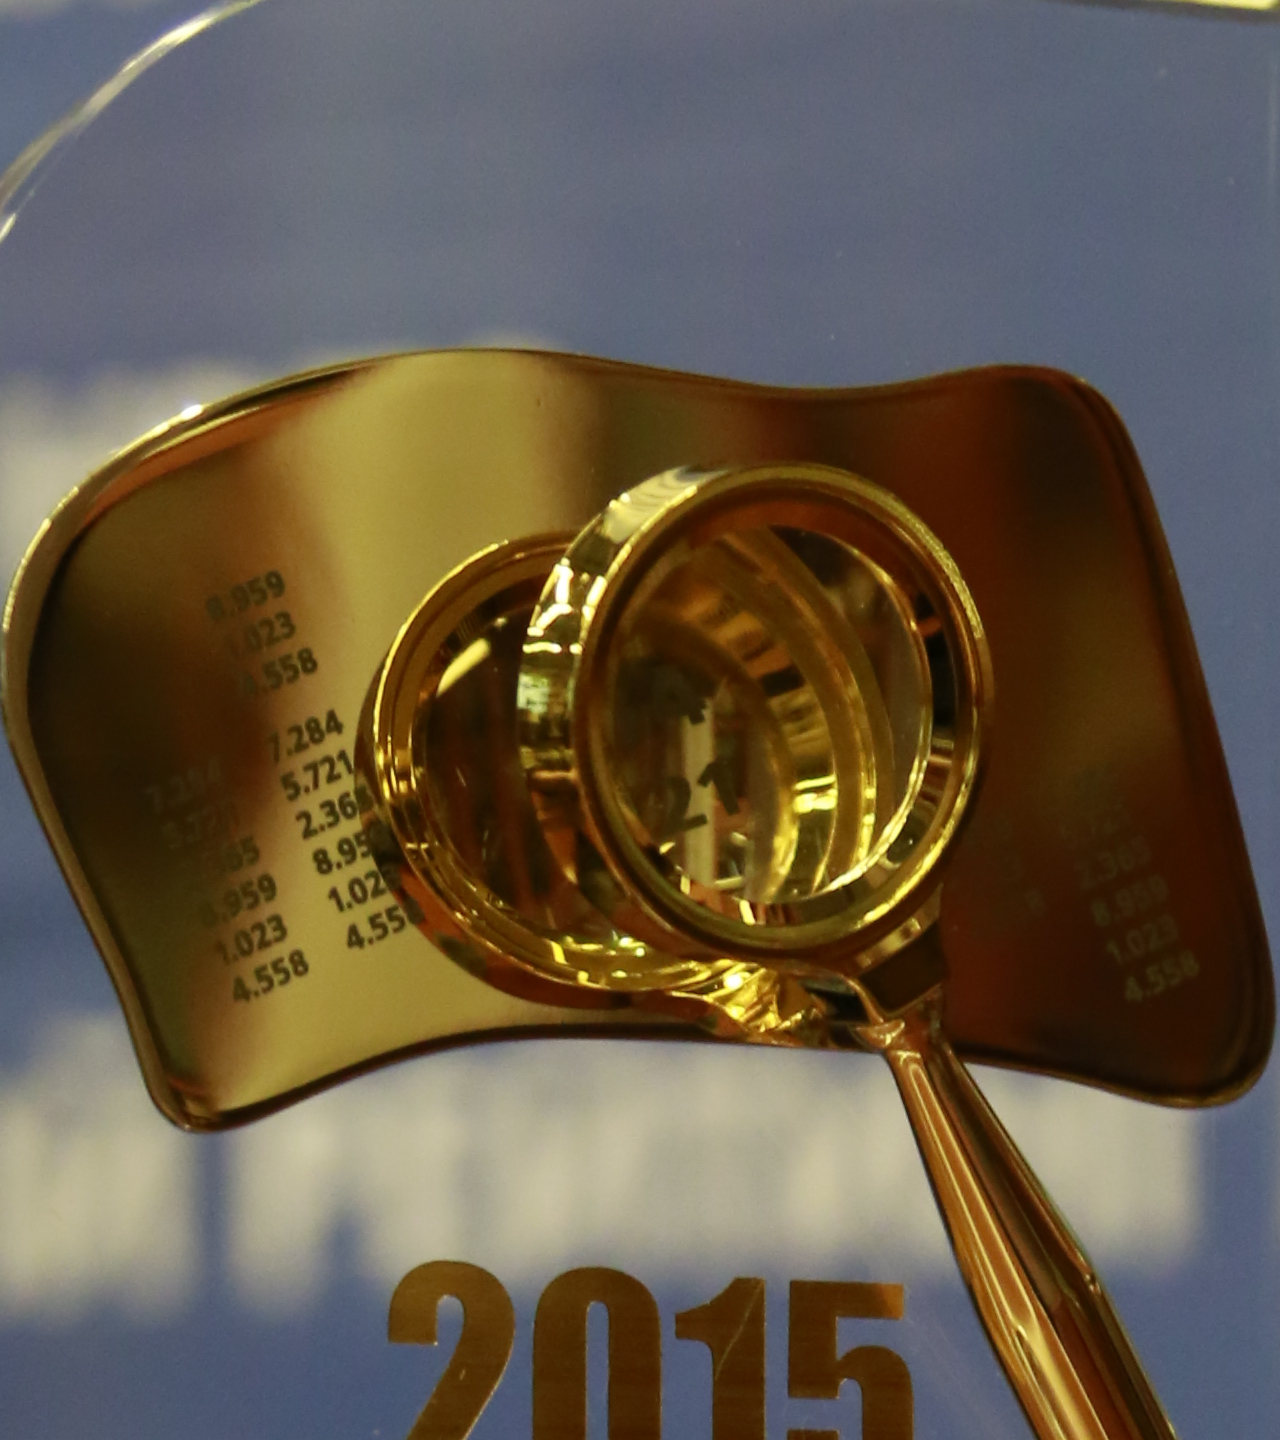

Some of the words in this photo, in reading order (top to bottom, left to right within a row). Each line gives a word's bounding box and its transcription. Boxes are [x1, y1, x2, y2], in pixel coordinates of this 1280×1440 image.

[280, 749, 355, 801] 5.721
[296, 791, 358, 840] 2.36
[313, 830, 372, 876] 8.95
[328, 869, 388, 913] 1.02
[346, 905, 407, 951] 4.55
[232, 949, 310, 1005] 4.558
